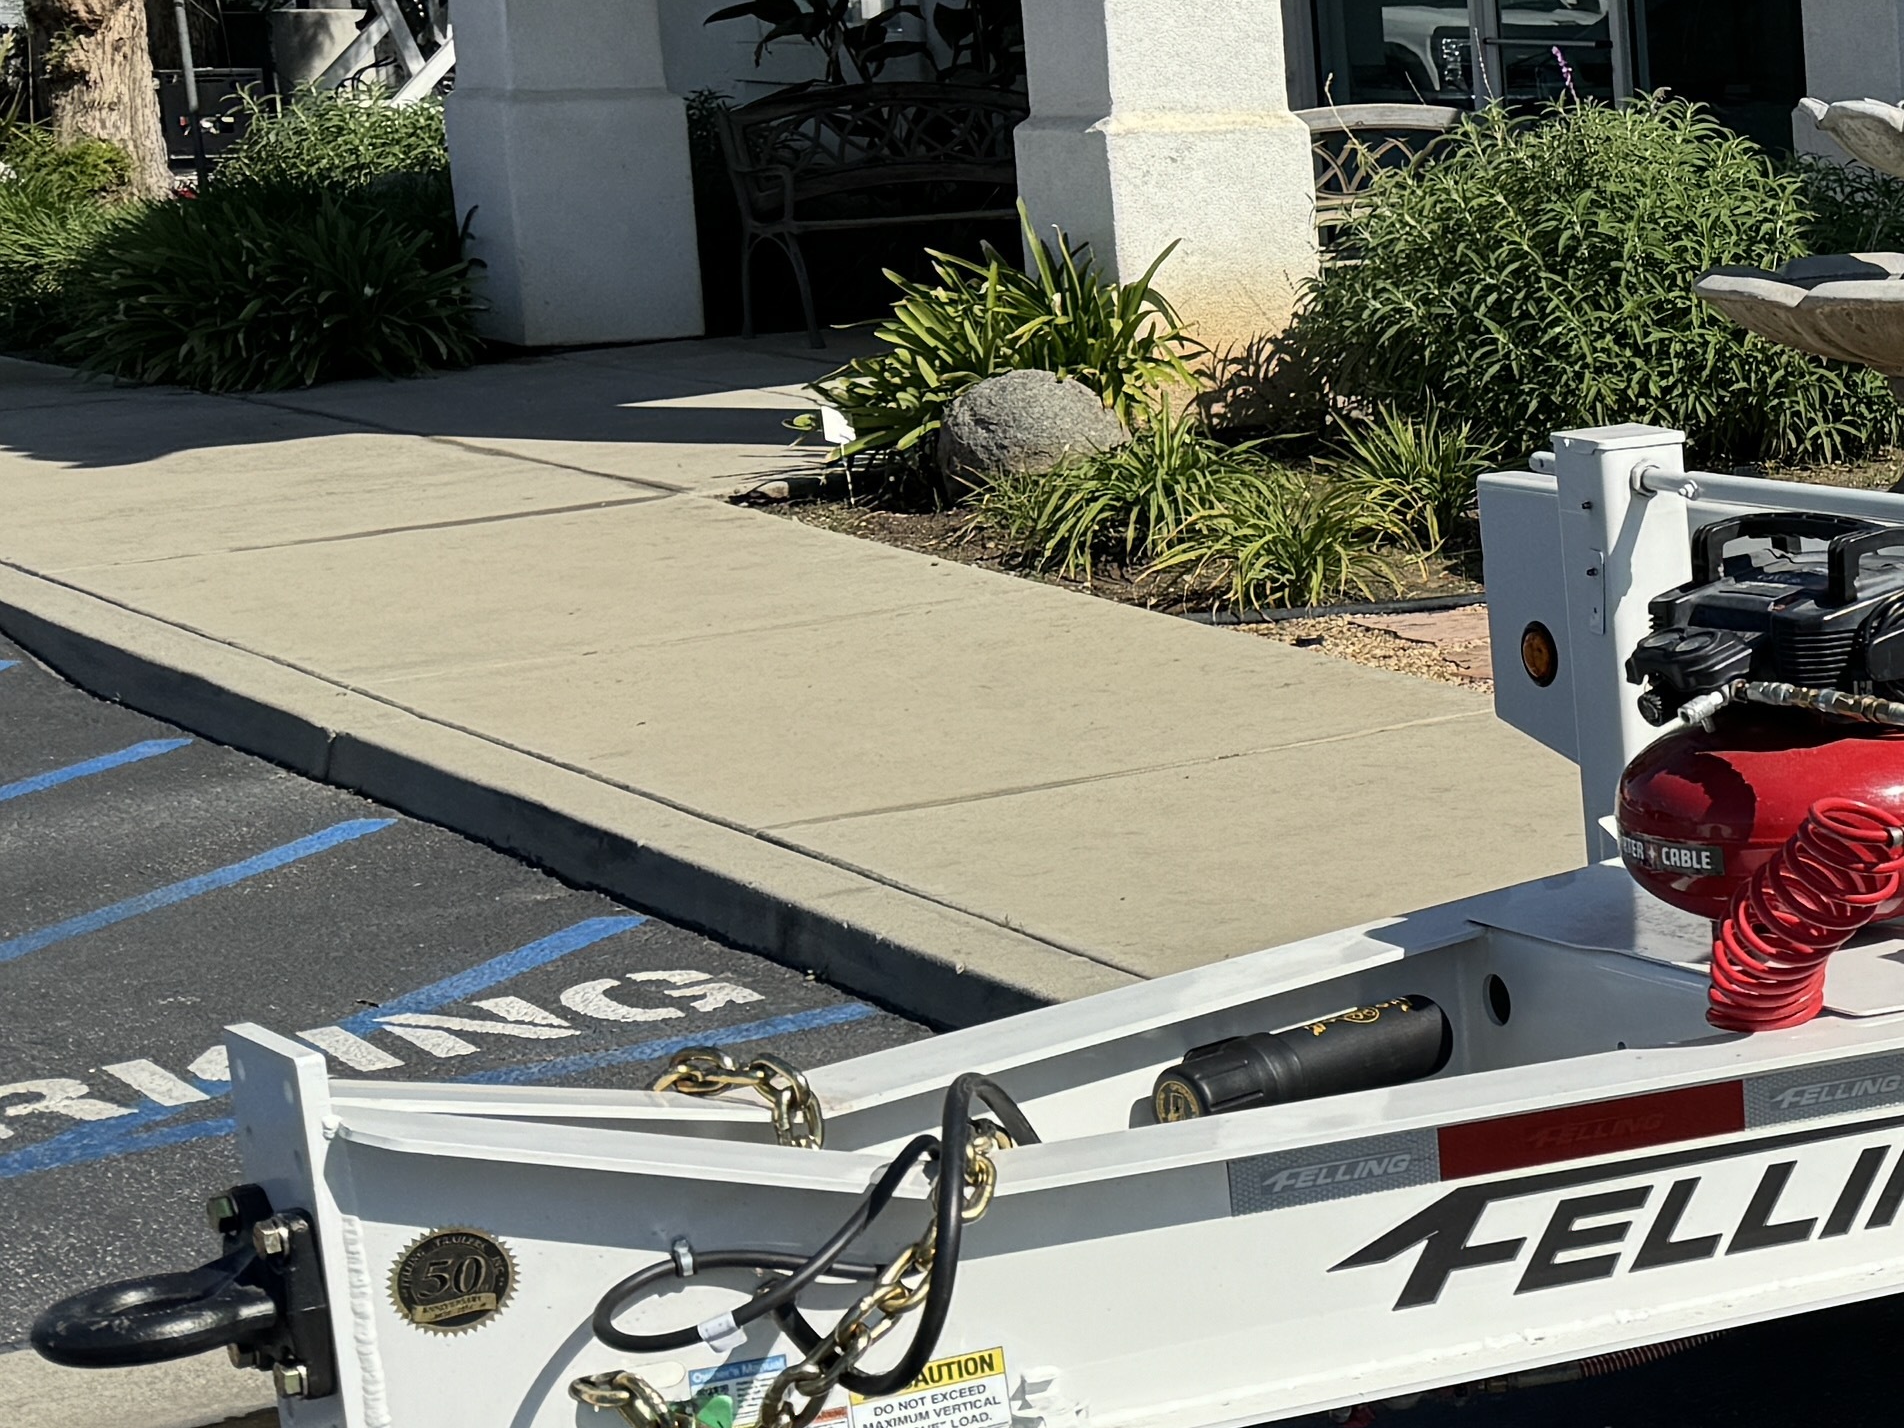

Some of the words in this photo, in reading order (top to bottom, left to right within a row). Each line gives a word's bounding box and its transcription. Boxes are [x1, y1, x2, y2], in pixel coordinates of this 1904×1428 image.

[1661, 847, 1712, 869] CABLE
[1771, 1075, 1902, 1110] FELLING
[1262, 1151, 1412, 1193] FELLING
[905, 1352, 995, 1389] AUTION
[873, 1403, 894, 1417] DO
[898, 1395, 926, 1412] NOT
[931, 1383, 986, 1404] EXCEED
[933, 1396, 1001, 1418] VERTICAL
[951, 1412, 993, 1428] LOAD.
